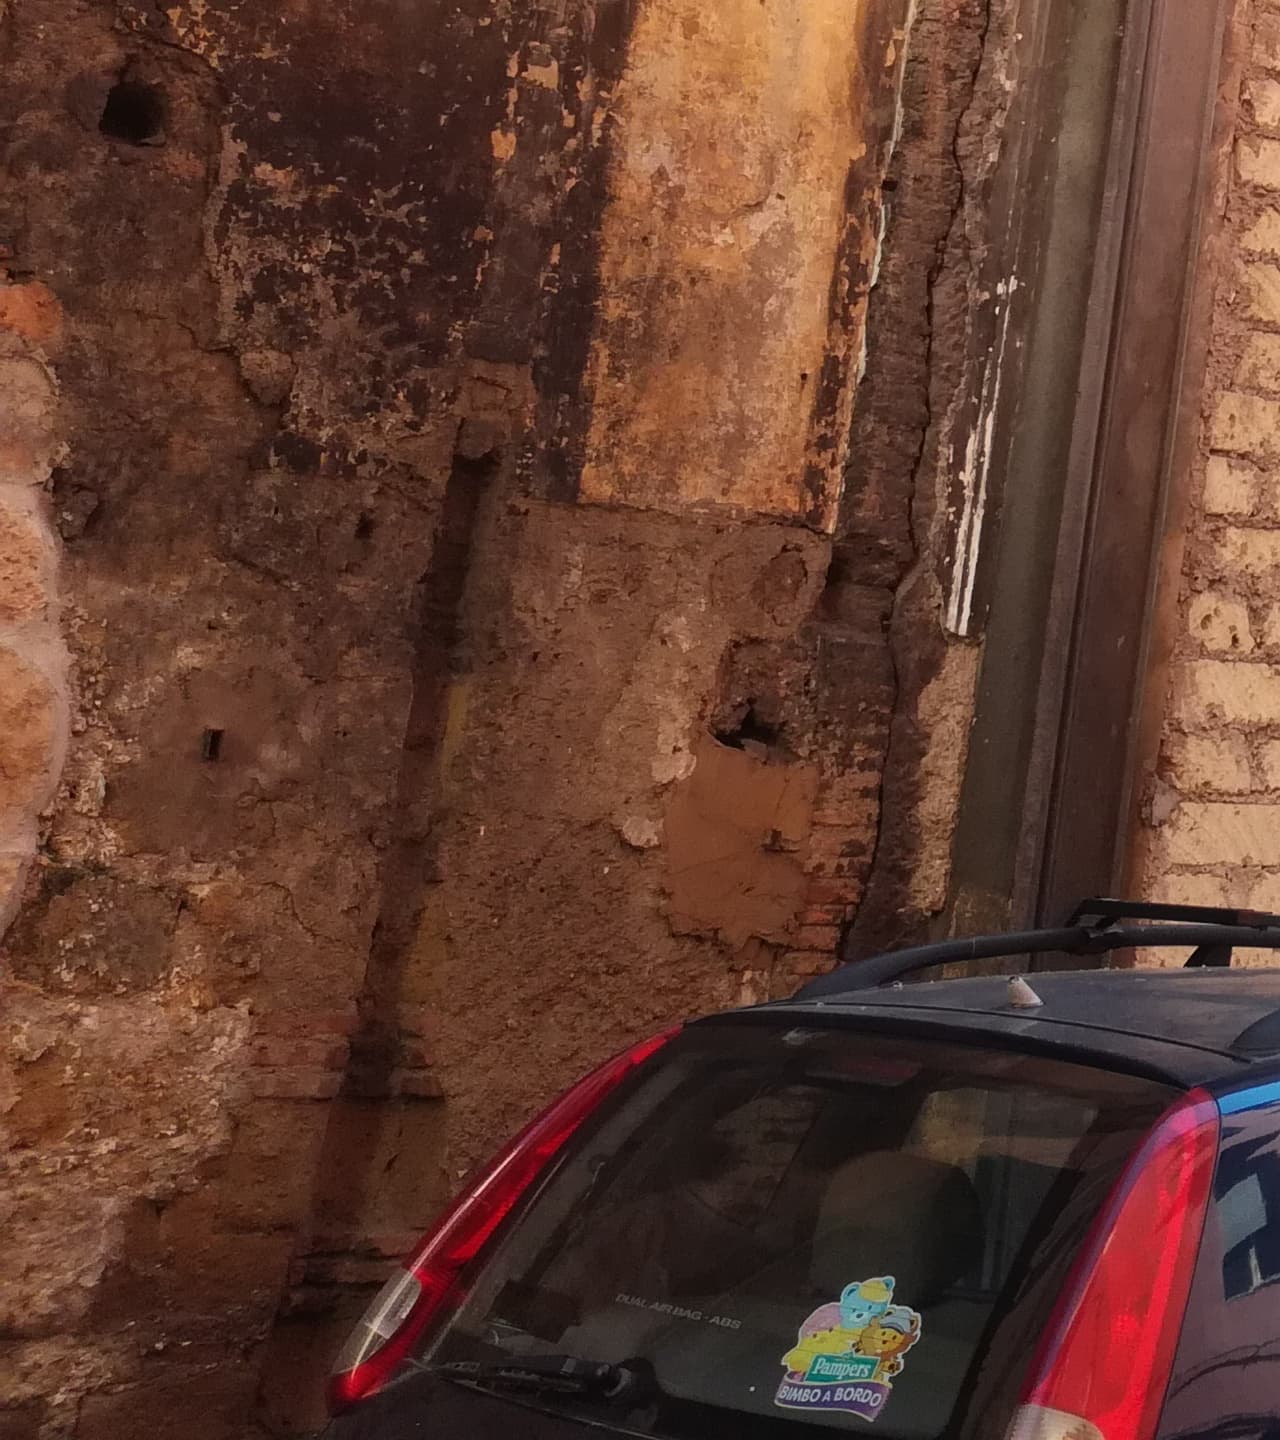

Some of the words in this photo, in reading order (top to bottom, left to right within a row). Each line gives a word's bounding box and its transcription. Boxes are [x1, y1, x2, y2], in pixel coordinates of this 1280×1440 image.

[708, 1315, 742, 1329] ABS
[811, 1357, 872, 1380] Pampers
[780, 1385, 821, 1402] BIMBO
[822, 1389, 832, 1403] A
[833, 1386, 882, 1407] BORDO
